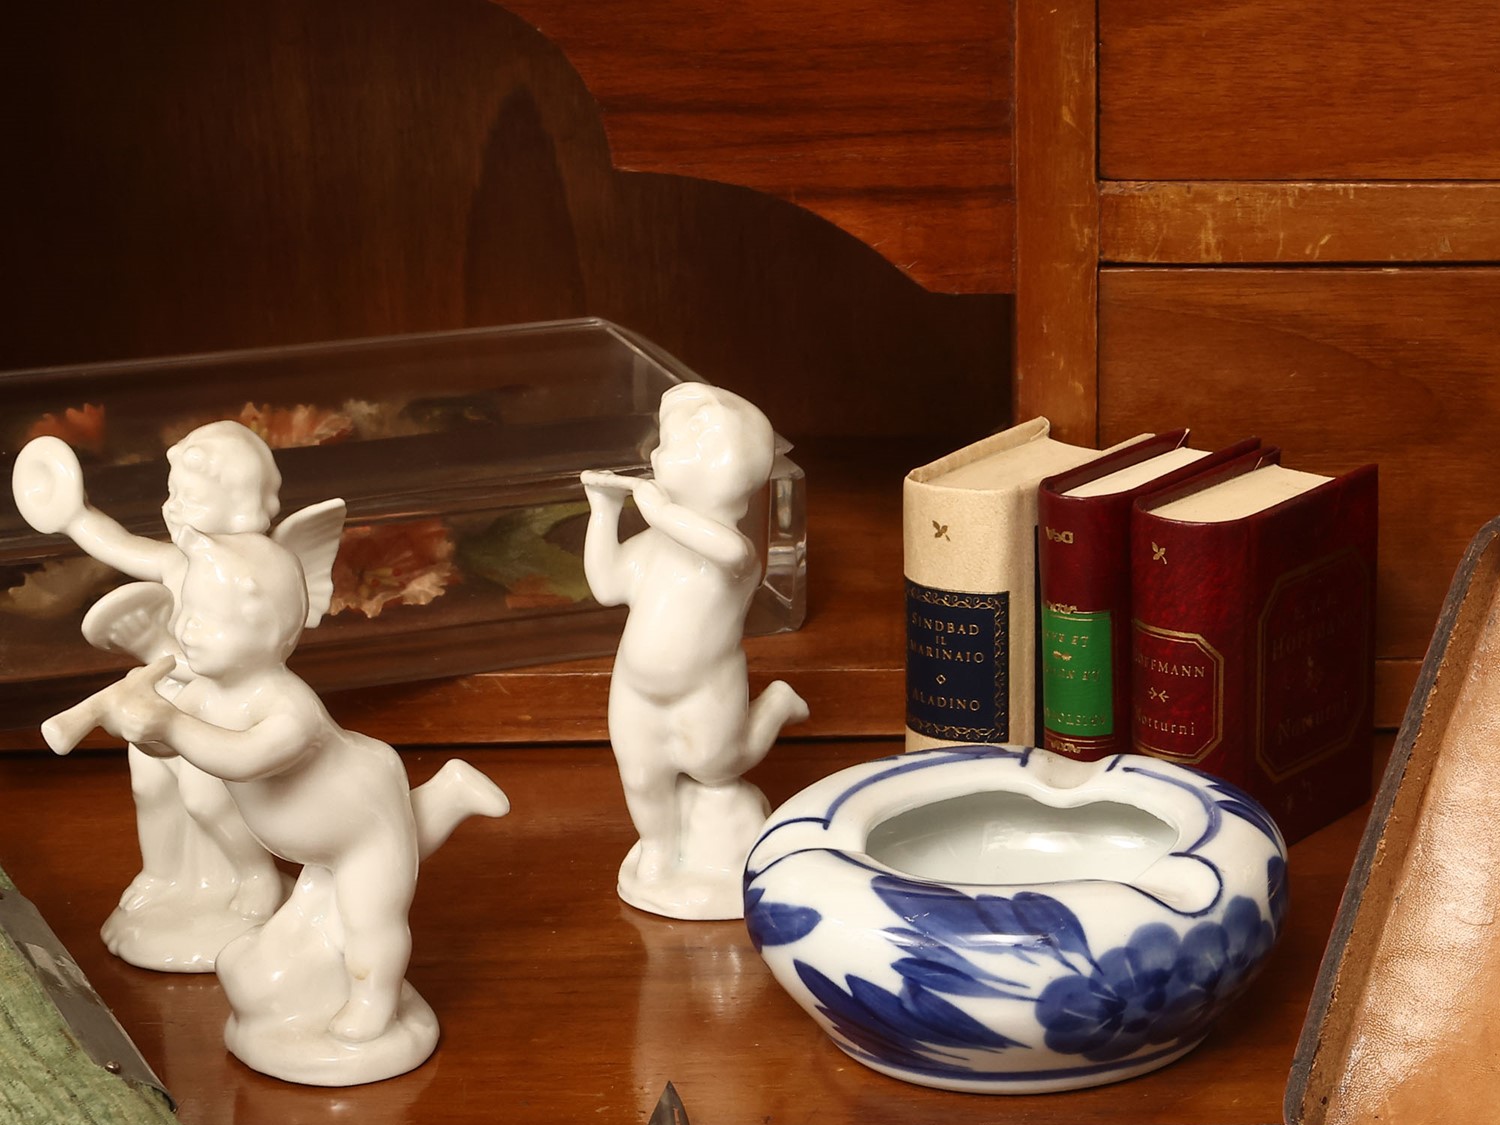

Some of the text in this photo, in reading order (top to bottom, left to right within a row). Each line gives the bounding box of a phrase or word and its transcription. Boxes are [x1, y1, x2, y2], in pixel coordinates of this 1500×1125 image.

[911, 612, 980, 636] SINDBAD
[1136, 653, 1206, 678] OFFMANN
[912, 687, 981, 712] ALADINO
